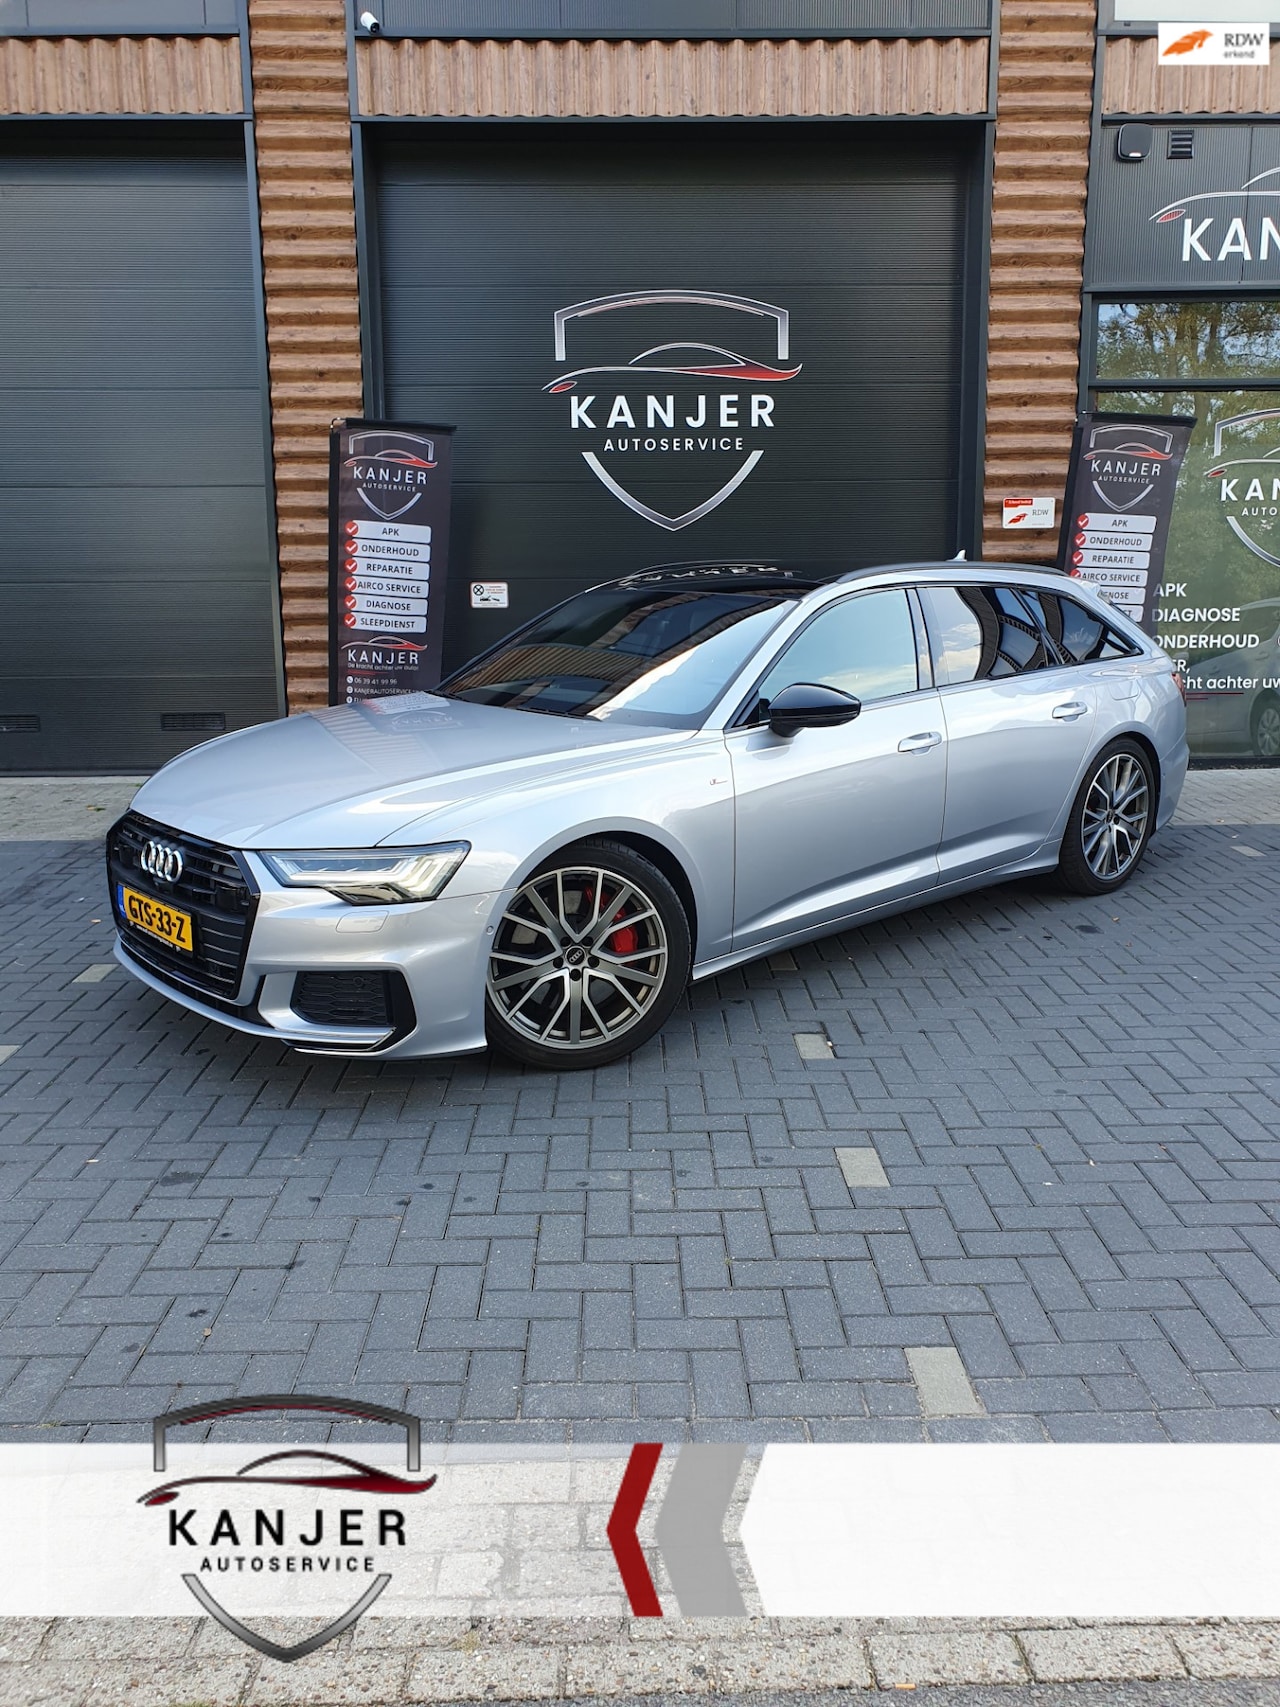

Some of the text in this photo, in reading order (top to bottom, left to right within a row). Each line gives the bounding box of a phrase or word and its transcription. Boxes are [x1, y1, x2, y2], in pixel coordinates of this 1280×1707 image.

[571, 394, 775, 429] KANJER
[604, 438, 744, 451] AUTOSERVICE
[1091, 459, 1161, 476] KANJER
[353, 466, 427, 485] KANJER
[1098, 475, 1150, 484] AUTOSERVICE
[362, 482, 416, 492] AUTOSERVICE
[1111, 519, 1128, 528] APK
[381, 527, 400, 537] APK
[1089, 536, 1142, 546] ONDERHOUD
[361, 544, 420, 557] ONDERHOUD
[1092, 554, 1134, 564] REPARATIE
[366, 563, 413, 575] REPARATIE
[1082, 572, 1140, 582] AIRCO SERVICE
[357, 580, 421, 594] AIRCO SERVICE
[1153, 583, 1187, 597] APK
[366, 600, 411, 611] DIAGNOSE
[1152, 607, 1241, 622] DIAGNOSE
[360, 617, 415, 629] SLEEPDIENST
[1153, 634, 1260, 649] ONDERHOUD
[348, 649, 418, 664] KANJER
[1206, 675, 1258, 689] achter
[128, 895, 186, 943] GTS-33-Z
